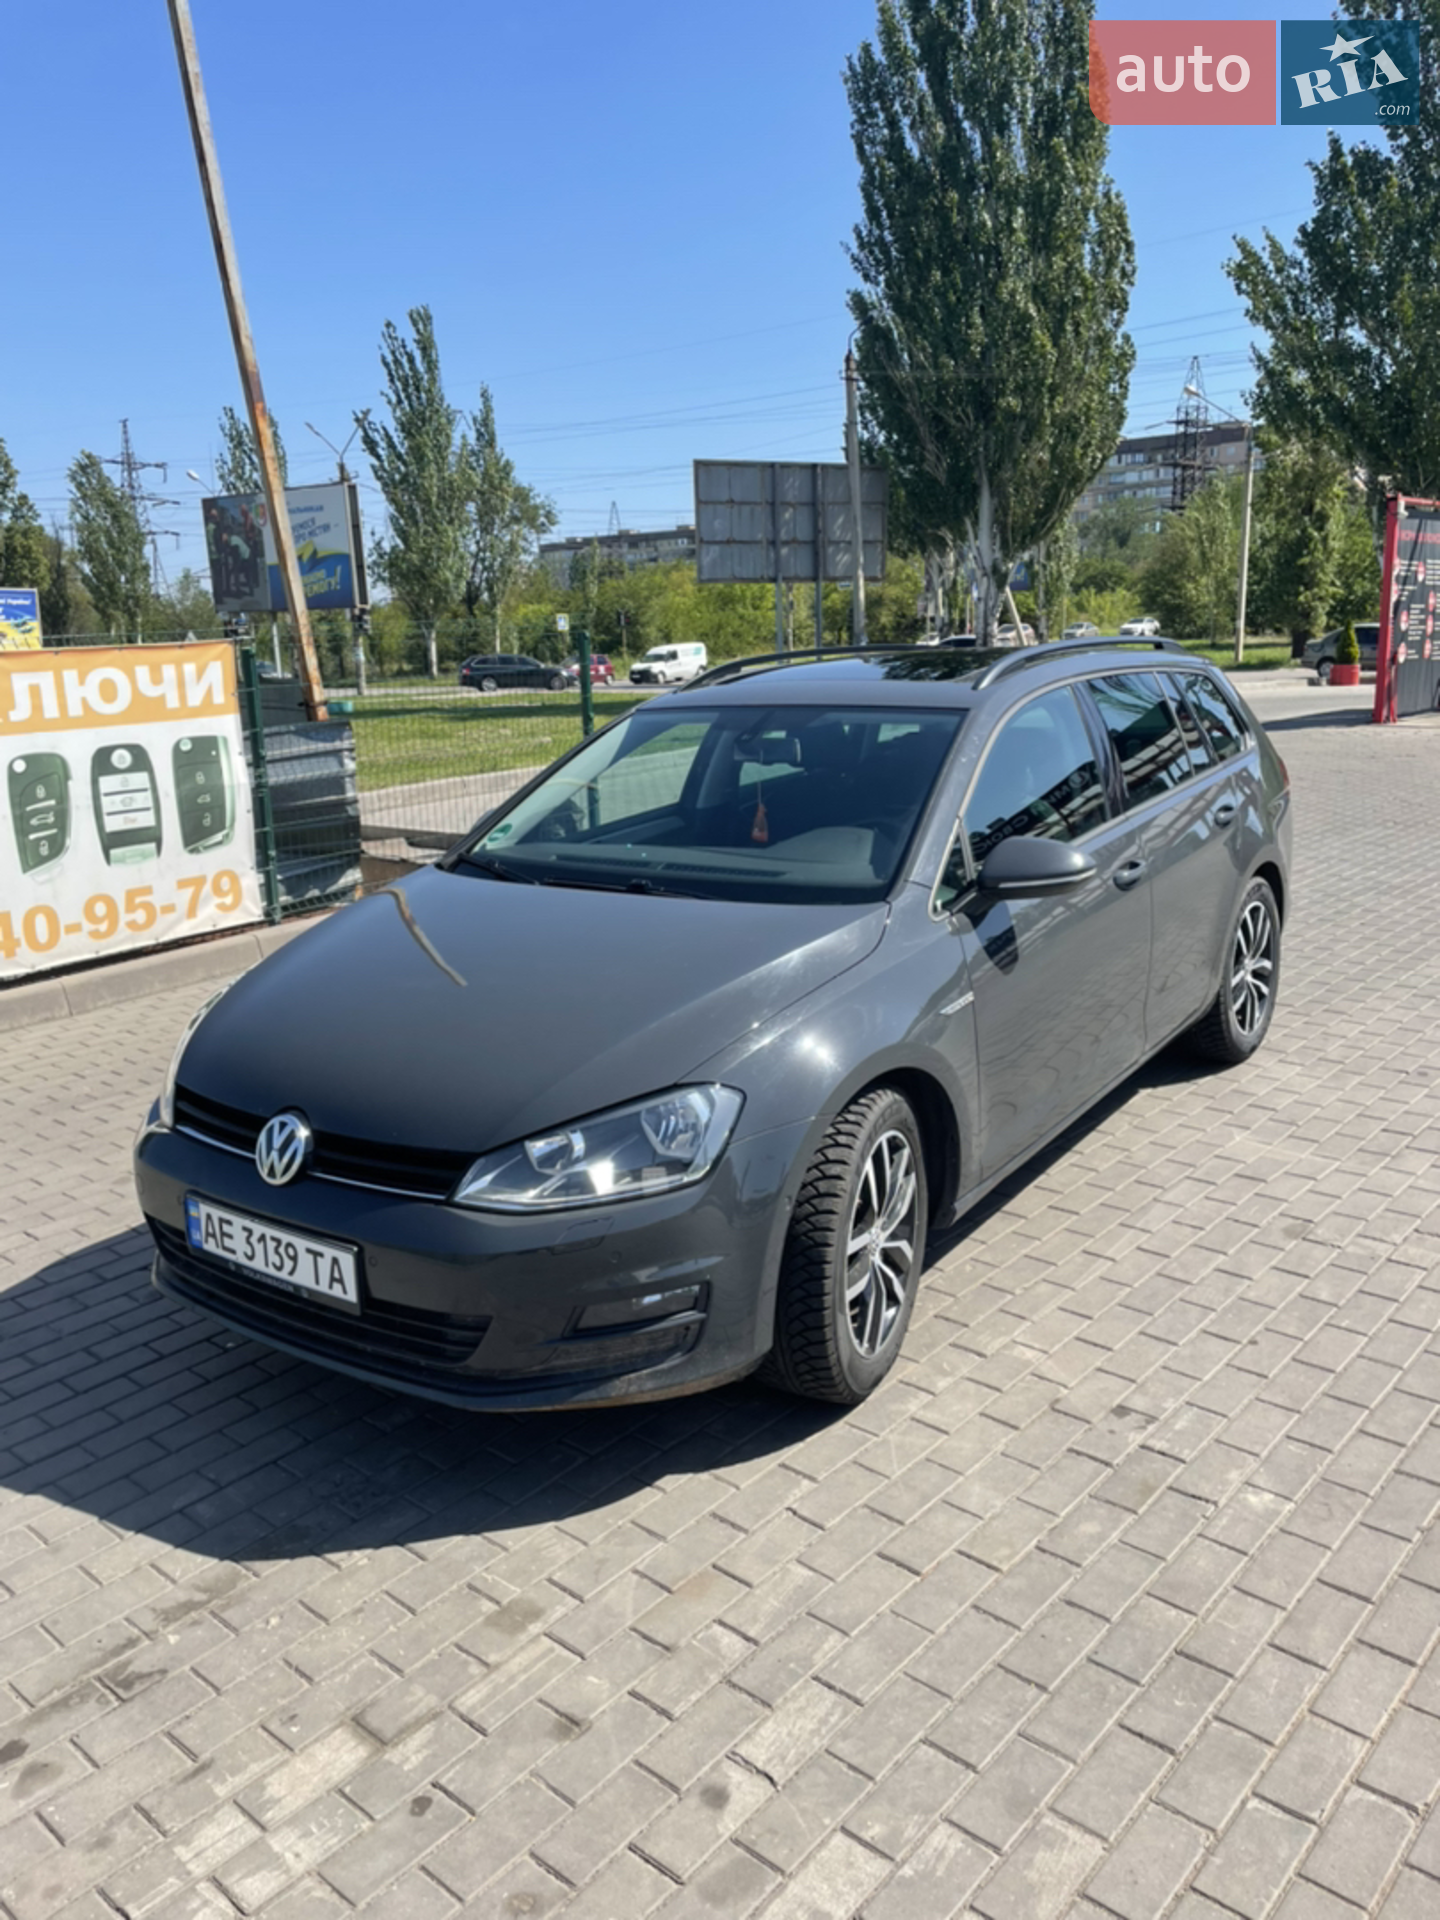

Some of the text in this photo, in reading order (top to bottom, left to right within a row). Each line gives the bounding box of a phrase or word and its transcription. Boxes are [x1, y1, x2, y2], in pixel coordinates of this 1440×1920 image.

[0, 661, 225, 723] ЛЮЧИ
[204, 1212, 348, 1296] AE 3139 TA
